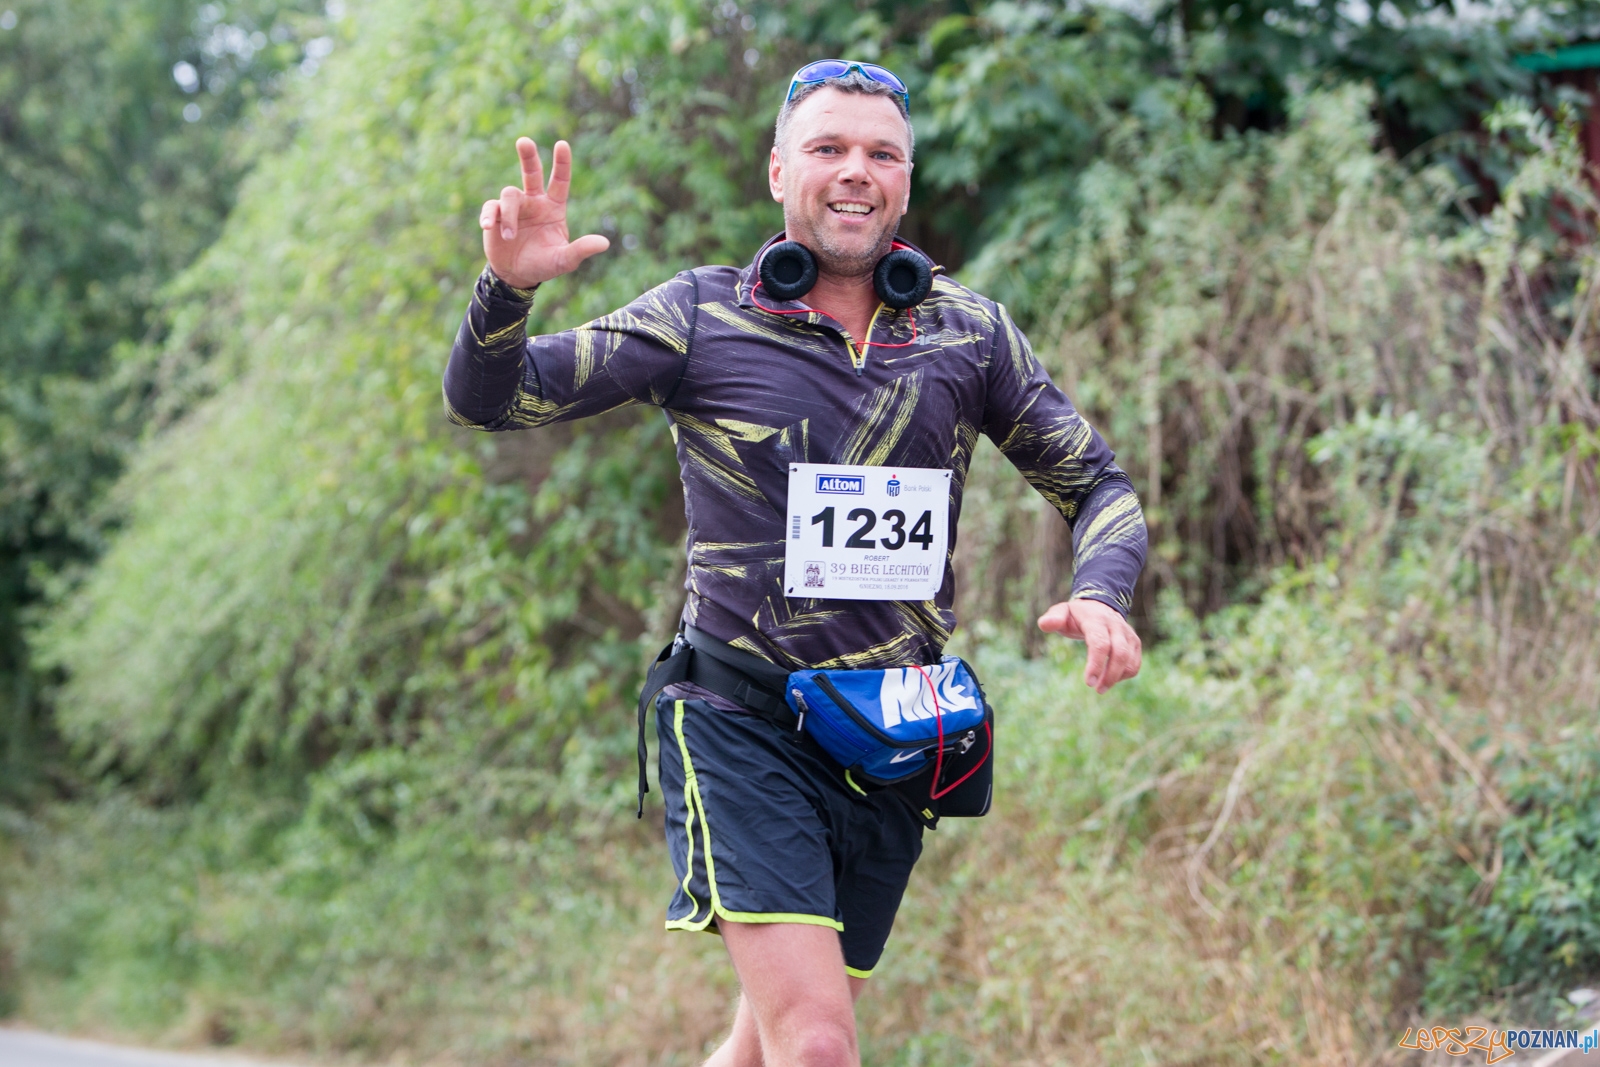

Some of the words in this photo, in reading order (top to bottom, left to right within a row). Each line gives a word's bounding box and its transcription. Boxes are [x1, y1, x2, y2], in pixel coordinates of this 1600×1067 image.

[903, 484, 917, 492] Bank
[918, 484, 932, 492] Polski
[810, 506, 934, 551] 1234
[863, 554, 890, 562] ROBERT
[830, 562, 847, 575] 39
[850, 563, 879, 575] BIEG
[882, 563, 932, 576] LECHITÓW
[880, 661, 977, 729] NIKE
